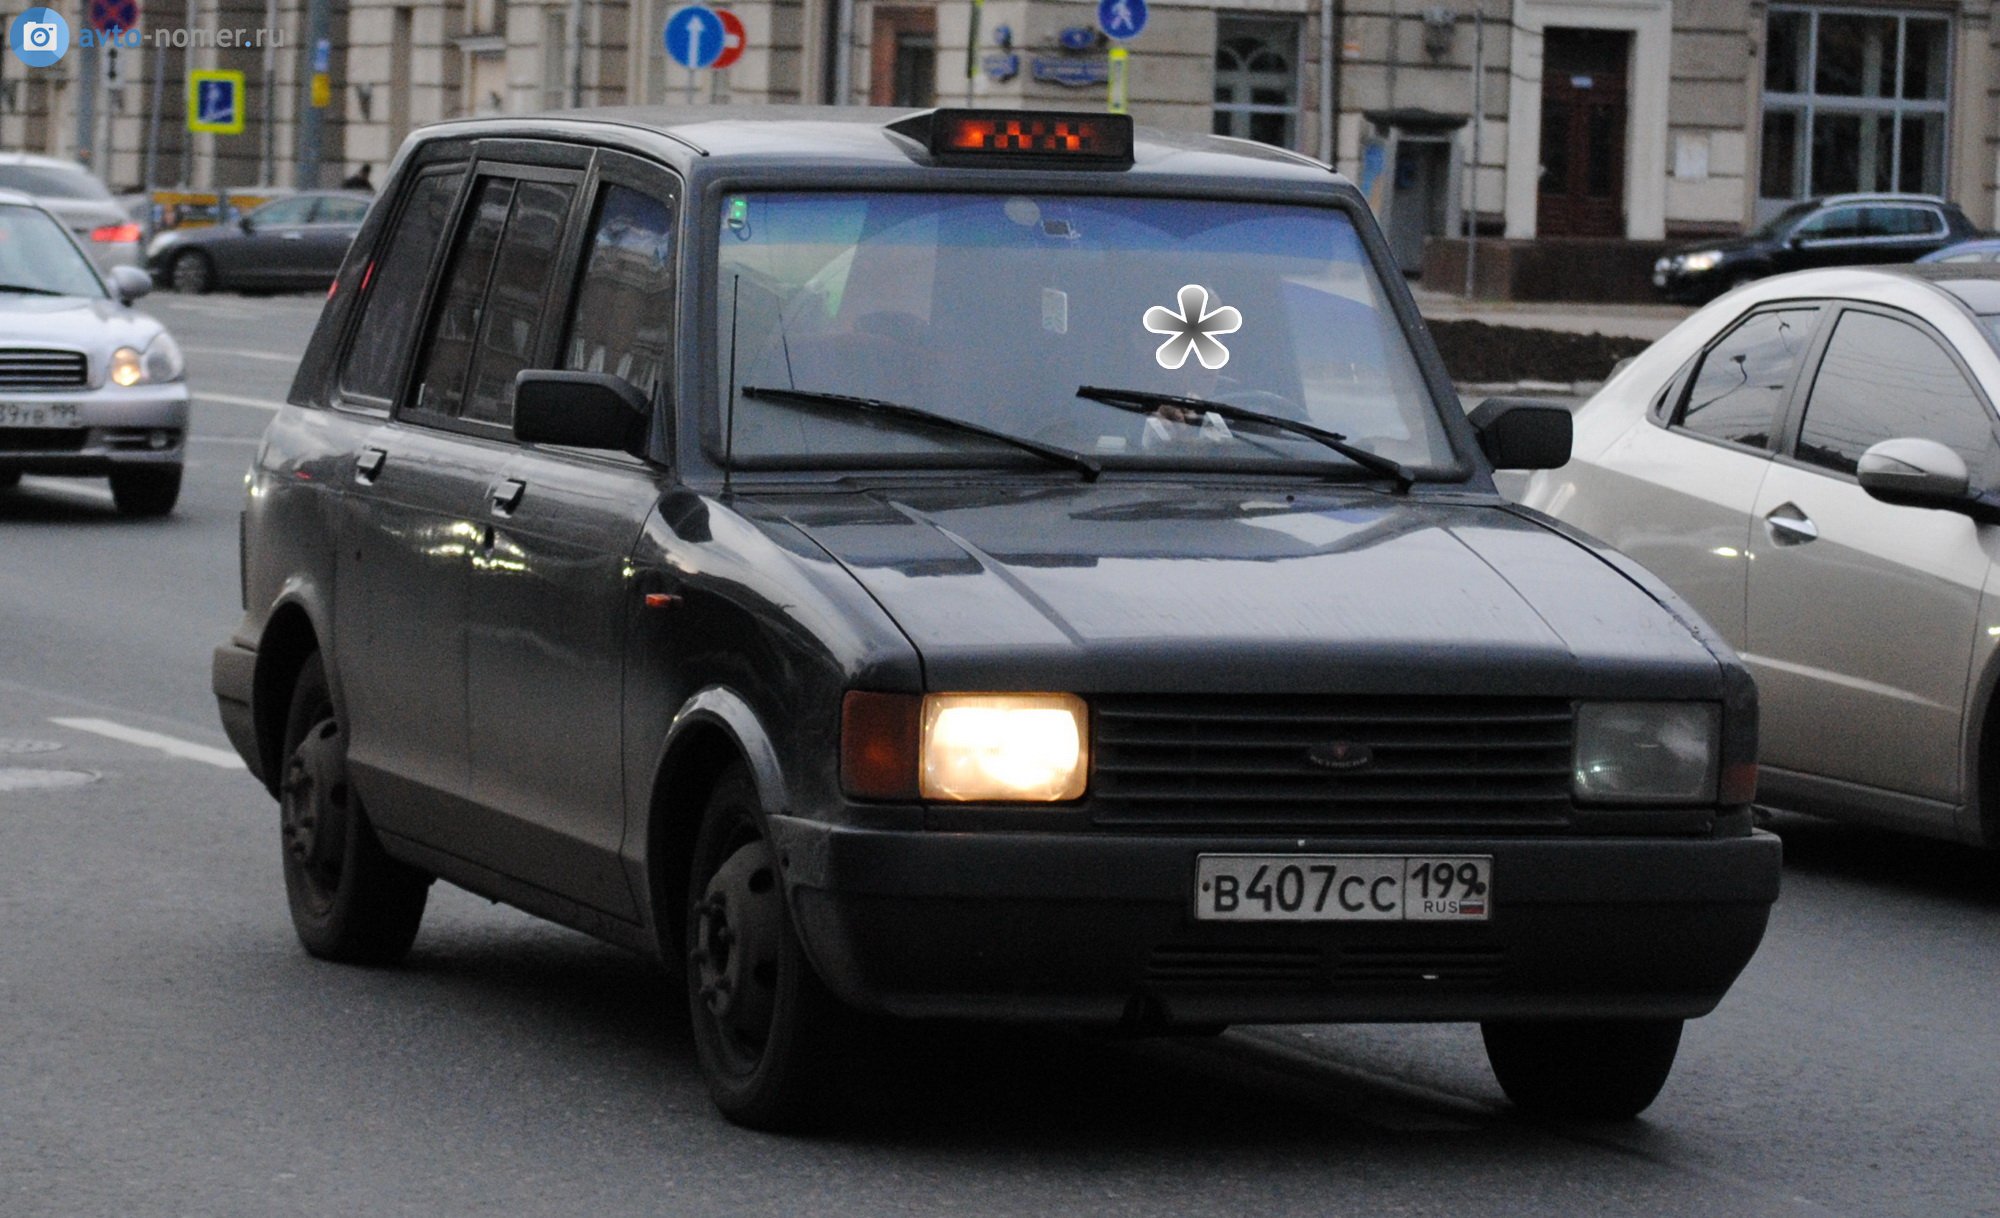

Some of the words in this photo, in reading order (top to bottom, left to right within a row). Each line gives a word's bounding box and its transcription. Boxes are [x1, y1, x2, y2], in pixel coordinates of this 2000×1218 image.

[1213, 864, 1397, 912] В407СС
[1411, 862, 1481, 899] 199
[1423, 901, 1458, 913] RUS
